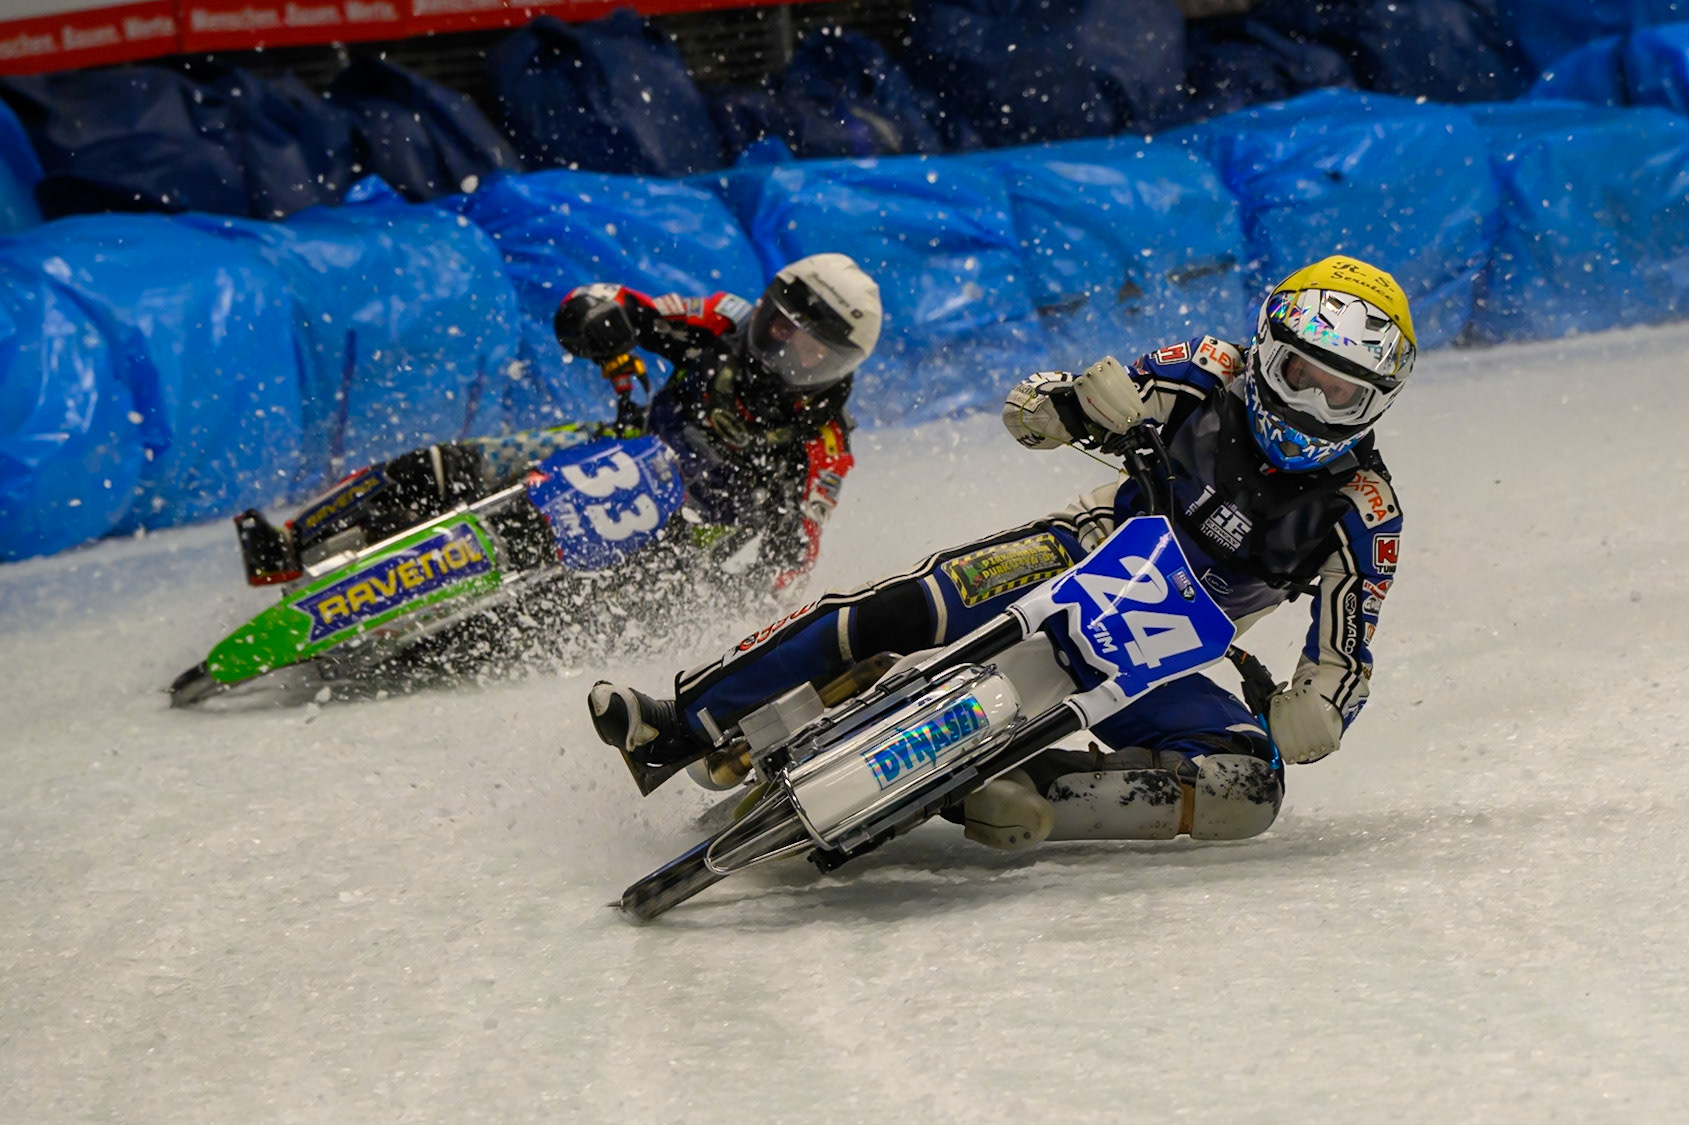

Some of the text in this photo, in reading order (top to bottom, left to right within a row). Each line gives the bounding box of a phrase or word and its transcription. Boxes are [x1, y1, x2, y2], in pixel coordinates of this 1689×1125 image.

[560, 451, 660, 542] 33
[317, 534, 484, 624] RAVENOL
[1075, 555, 1203, 669] 24
[1087, 618, 1118, 654] FIM
[874, 698, 980, 782] DYNASET
